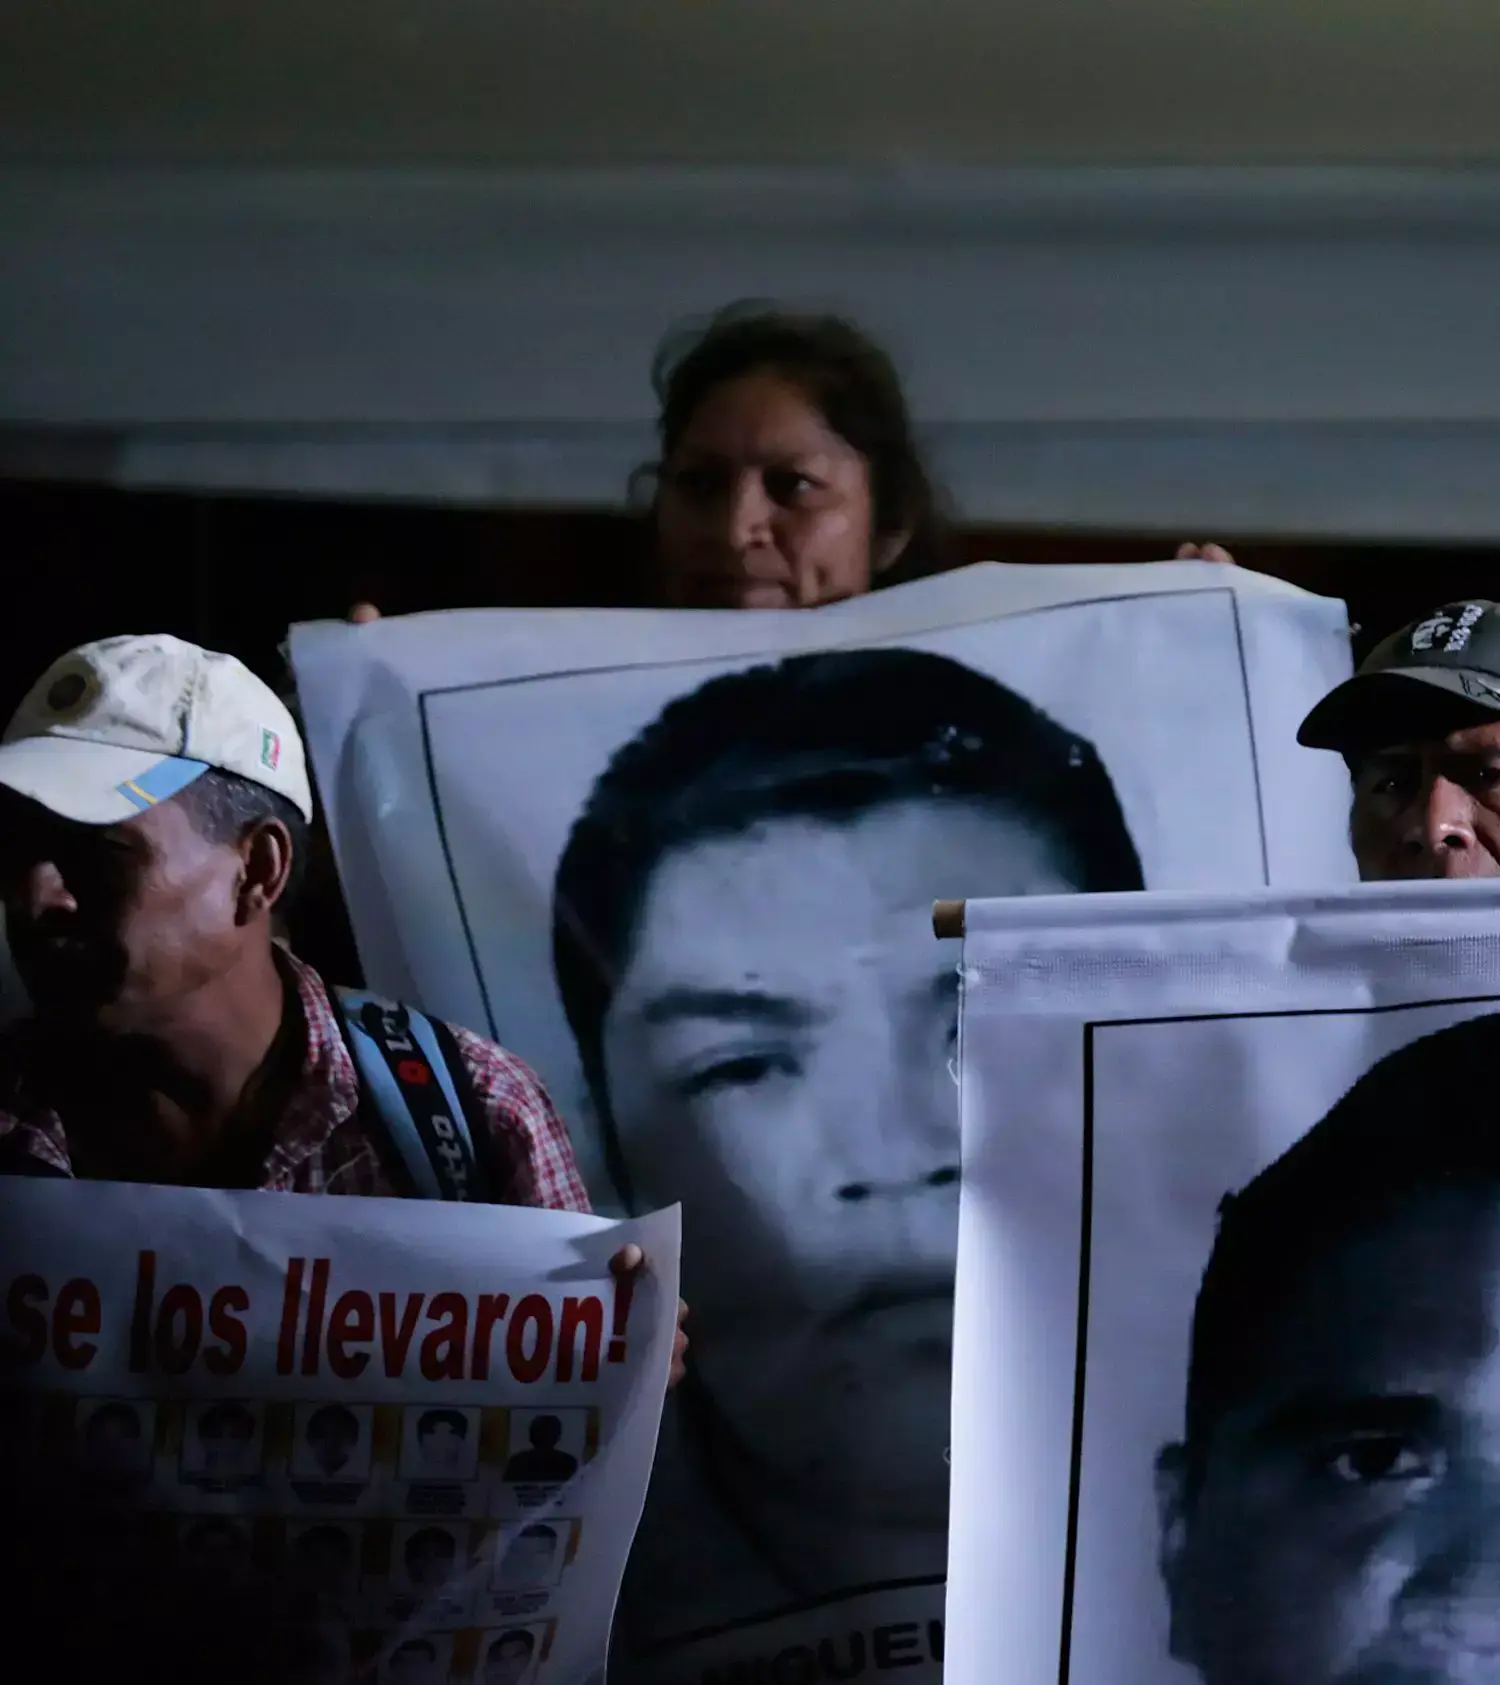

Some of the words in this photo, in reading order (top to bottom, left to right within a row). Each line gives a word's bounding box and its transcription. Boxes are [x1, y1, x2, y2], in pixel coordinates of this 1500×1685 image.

[6, 1272, 102, 1370] se
[129, 1250, 250, 1375] los
[276, 1257, 636, 1383] llevaron!
